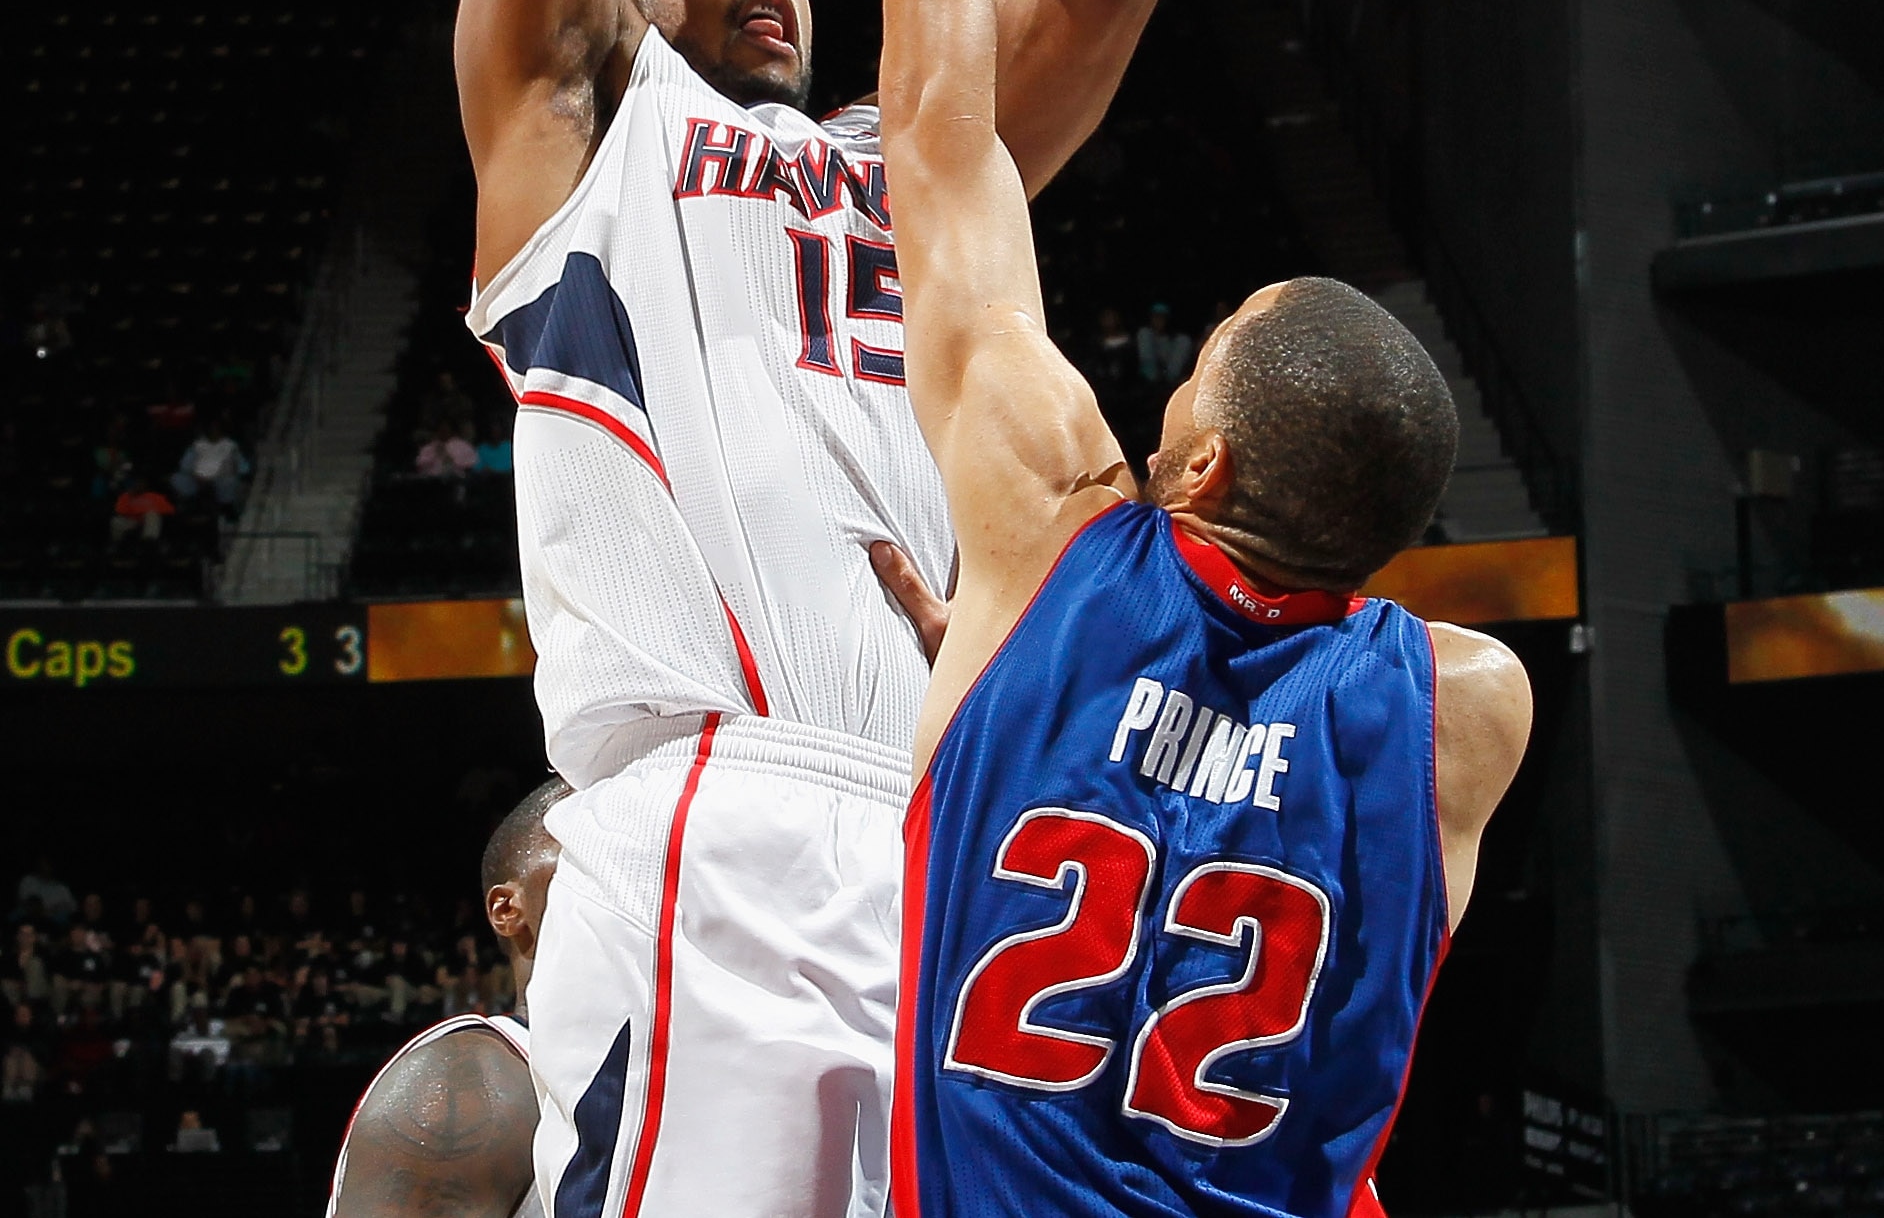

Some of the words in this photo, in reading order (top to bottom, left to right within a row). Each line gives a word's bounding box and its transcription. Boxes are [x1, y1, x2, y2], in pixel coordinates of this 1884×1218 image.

[673, 117, 893, 231] HAW
[785, 227, 906, 387] 15
[6, 628, 135, 686] Caps
[278, 627, 307, 675] 3
[334, 626, 363, 674] 3
[1109, 677, 1296, 812] PRINCE
[944, 807, 1331, 1147] 22
